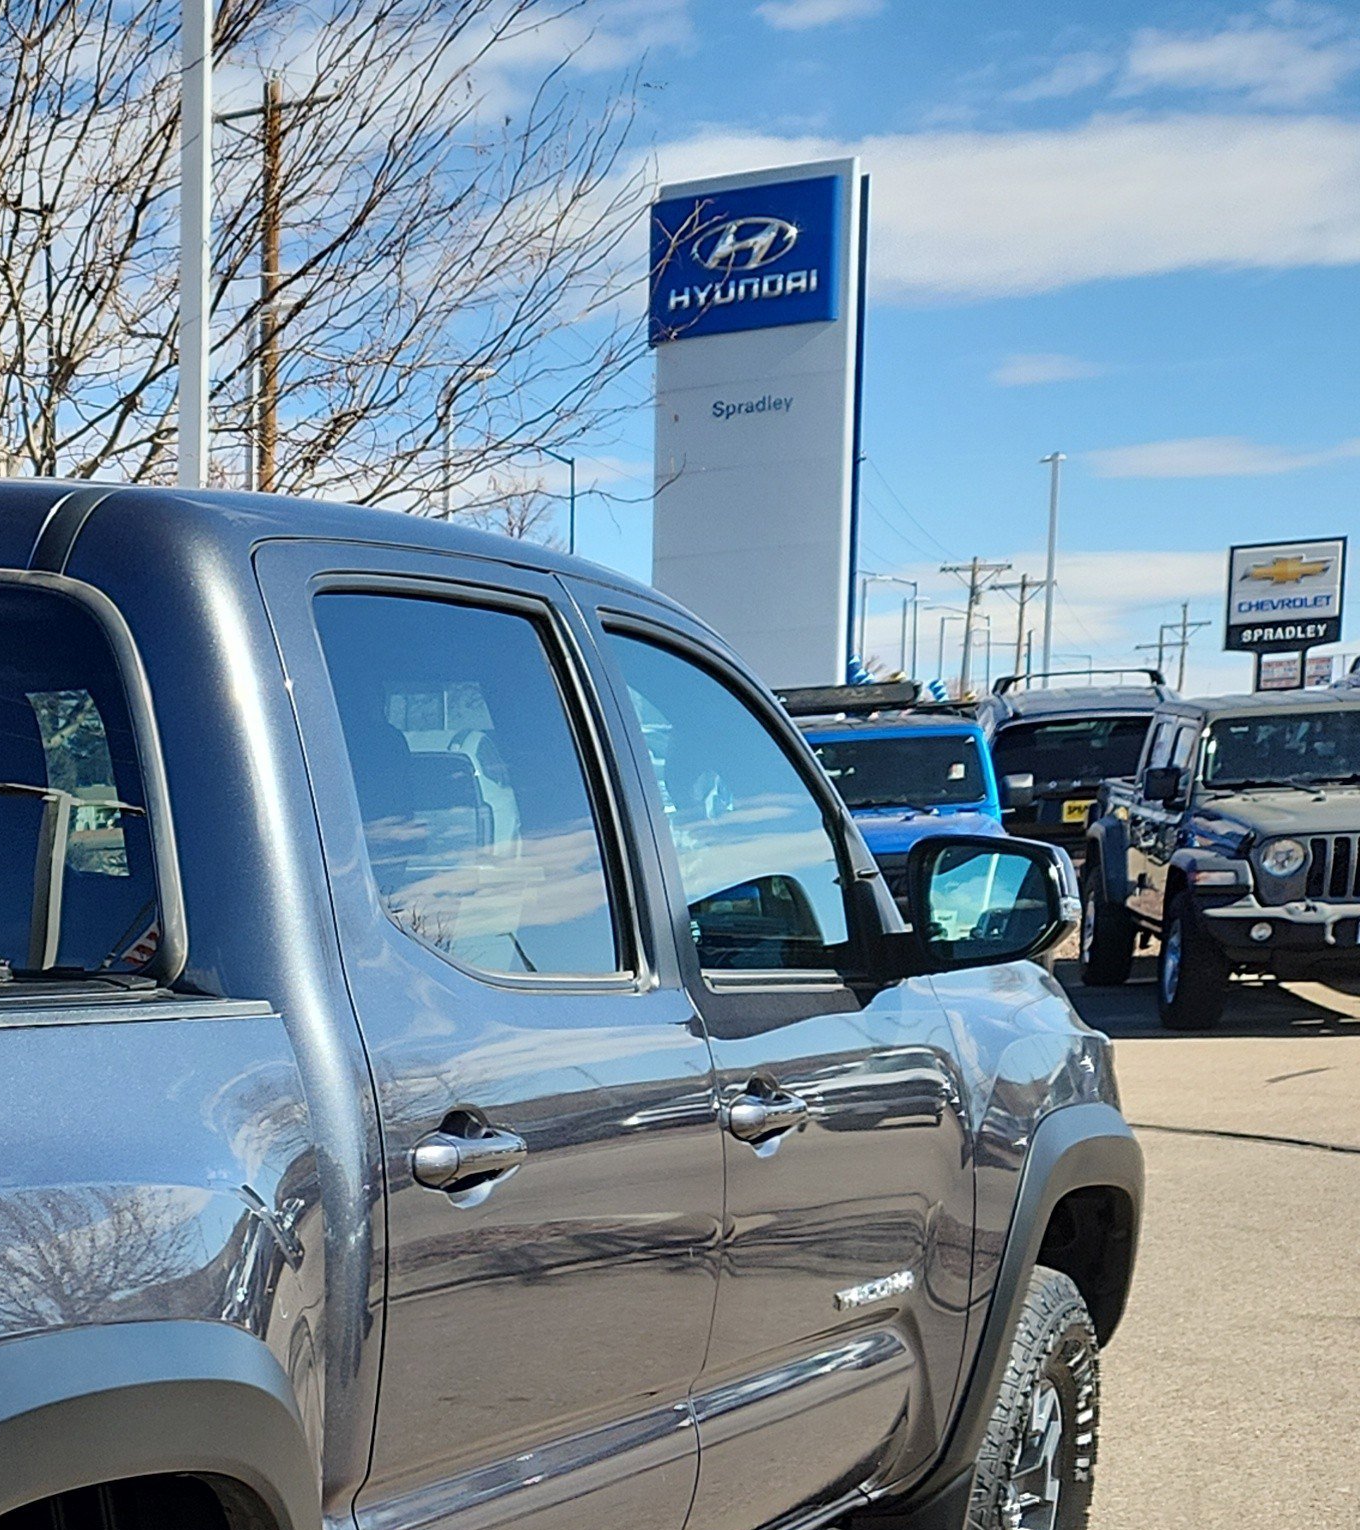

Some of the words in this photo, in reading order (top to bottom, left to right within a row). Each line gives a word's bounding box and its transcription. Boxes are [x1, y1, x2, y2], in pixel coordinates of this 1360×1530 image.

[668, 269, 818, 311] HYUNDAI
[711, 395, 795, 421] Spradley
[1237, 594, 1333, 614] CHEVROLET
[1241, 623, 1328, 643] SPRADLEY
